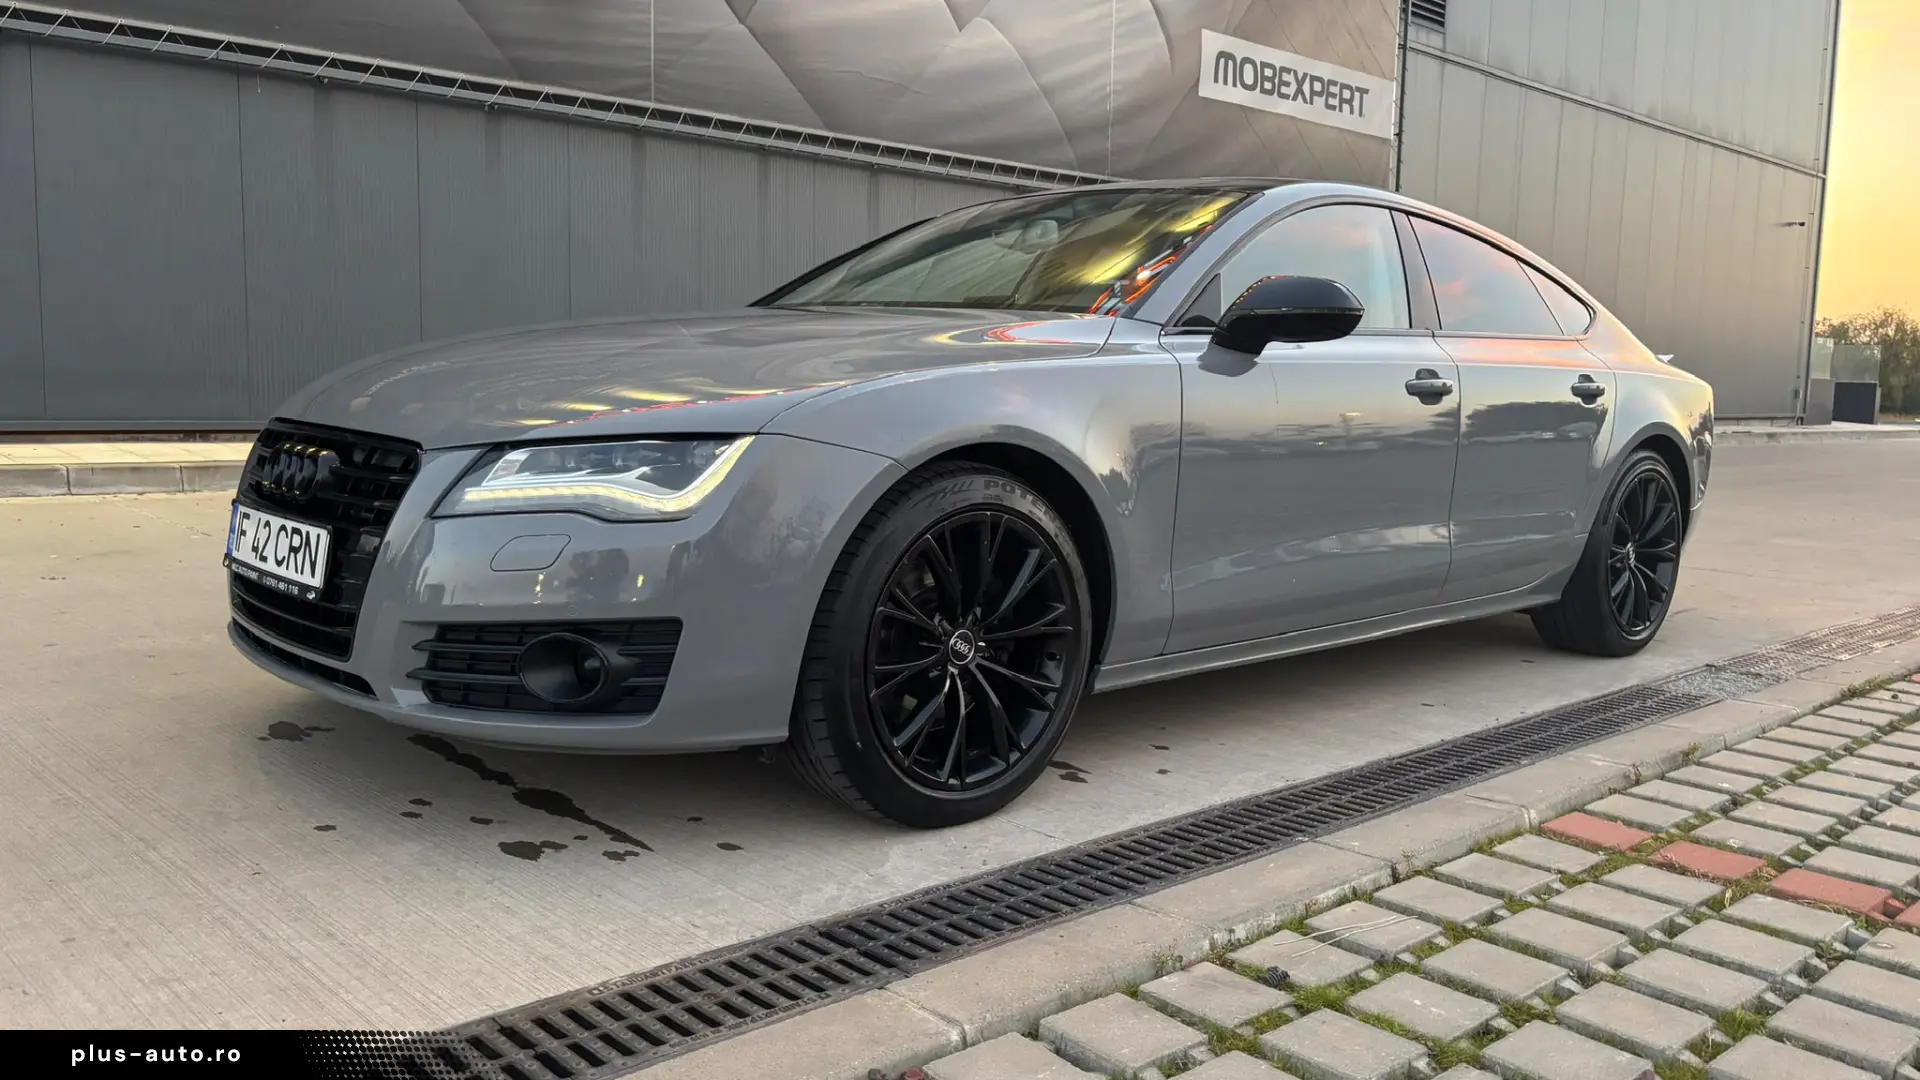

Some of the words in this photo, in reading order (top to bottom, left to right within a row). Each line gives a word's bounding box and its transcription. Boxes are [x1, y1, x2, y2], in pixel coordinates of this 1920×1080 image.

[1213, 50, 1370, 117] MOBEXPERT
[235, 510, 251, 552] IF
[251, 517, 271, 563] 42
[274, 524, 321, 579] CRN
